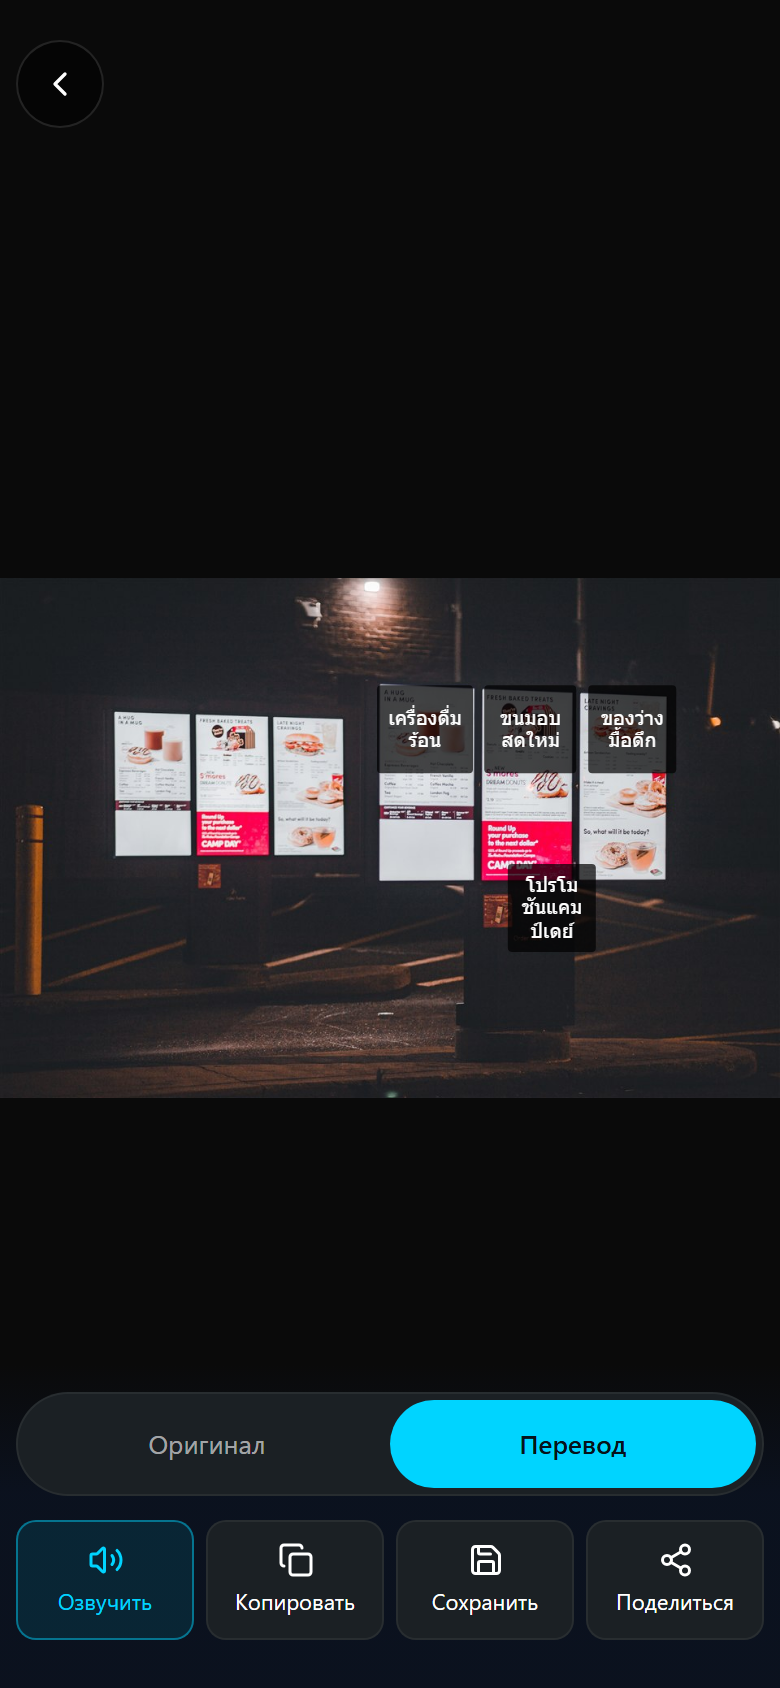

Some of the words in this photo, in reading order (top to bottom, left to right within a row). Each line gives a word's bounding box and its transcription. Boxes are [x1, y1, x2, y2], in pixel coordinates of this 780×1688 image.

[583, 704, 616, 712] CRAVINGS
[507, 825, 516, 833] Up
[630, 828, 649, 836] today?
[501, 832, 529, 840] purchase
[487, 860, 516, 870] CAMP
[516, 860, 533, 870] DAY
